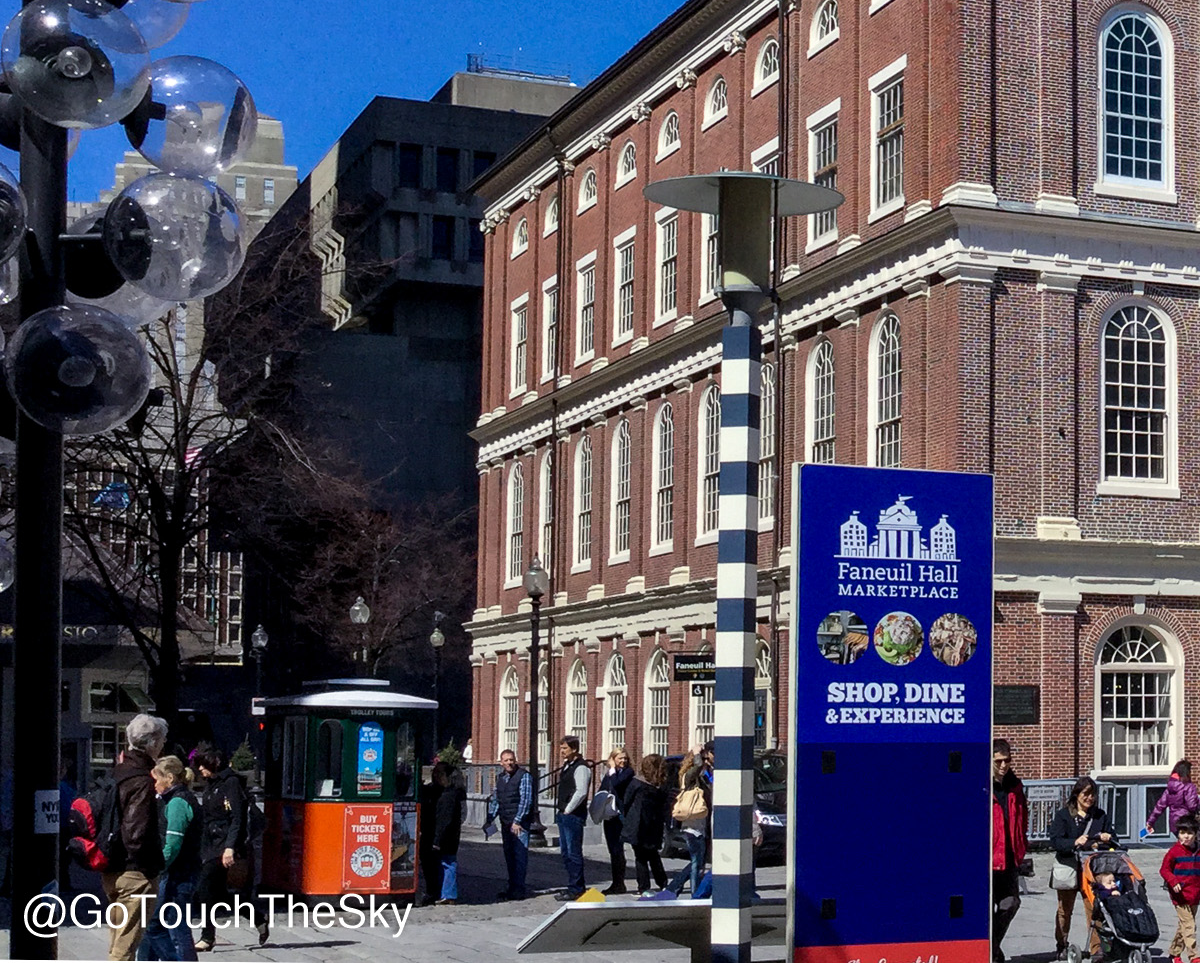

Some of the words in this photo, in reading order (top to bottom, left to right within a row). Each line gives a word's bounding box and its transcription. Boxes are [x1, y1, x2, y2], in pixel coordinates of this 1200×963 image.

[838, 562, 913, 582] Faneuil
[919, 564, 959, 583] Hall
[838, 584, 959, 599] MARKETPLACE
[827, 681, 900, 705] SHOP,
[904, 683, 966, 704] DINE
[359, 814, 378, 824] BUY
[351, 824, 386, 834] TICKETS
[356, 834, 380, 843] HERE
